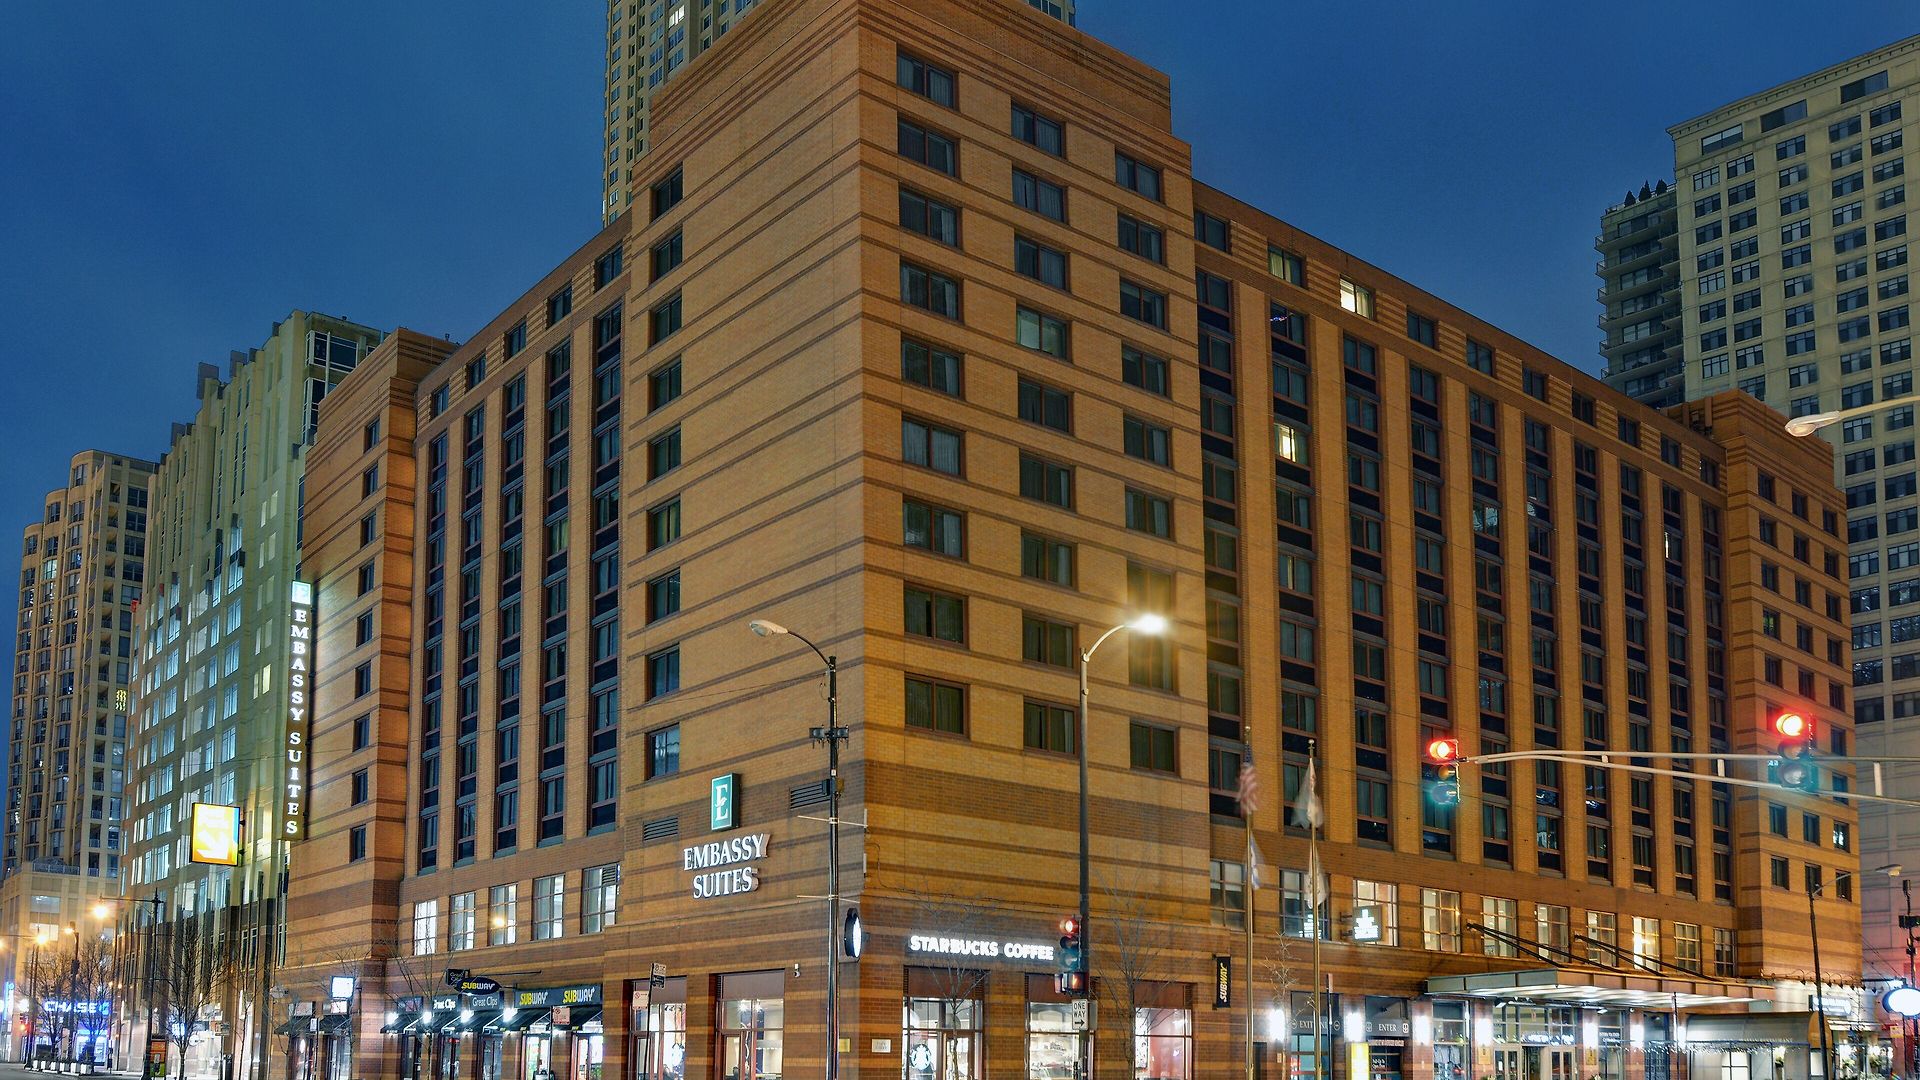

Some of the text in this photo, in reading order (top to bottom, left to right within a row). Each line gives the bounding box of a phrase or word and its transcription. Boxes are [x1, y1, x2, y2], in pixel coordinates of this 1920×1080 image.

[286, 608, 309, 834] EMBASSY SUITES
[715, 784, 728, 820] E
[684, 833, 770, 870] EMBASSY
[693, 867, 759, 898] SUITES
[910, 935, 1054, 960] STARBUCKS COFFEE
[461, 981, 495, 990] SUBWAY
[472, 994, 498, 1008] Great Clips
[519, 991, 548, 1006] SUBWAY
[563, 987, 595, 1004] SUBWAY
[44, 1001, 97, 1013] CHASE
[445, 998, 455, 1010] Clips
[1073, 1002, 1086, 1010] ONE
[1299, 1020, 1314, 1029] EXIT
[1378, 1023, 1397, 1032] ENTER
